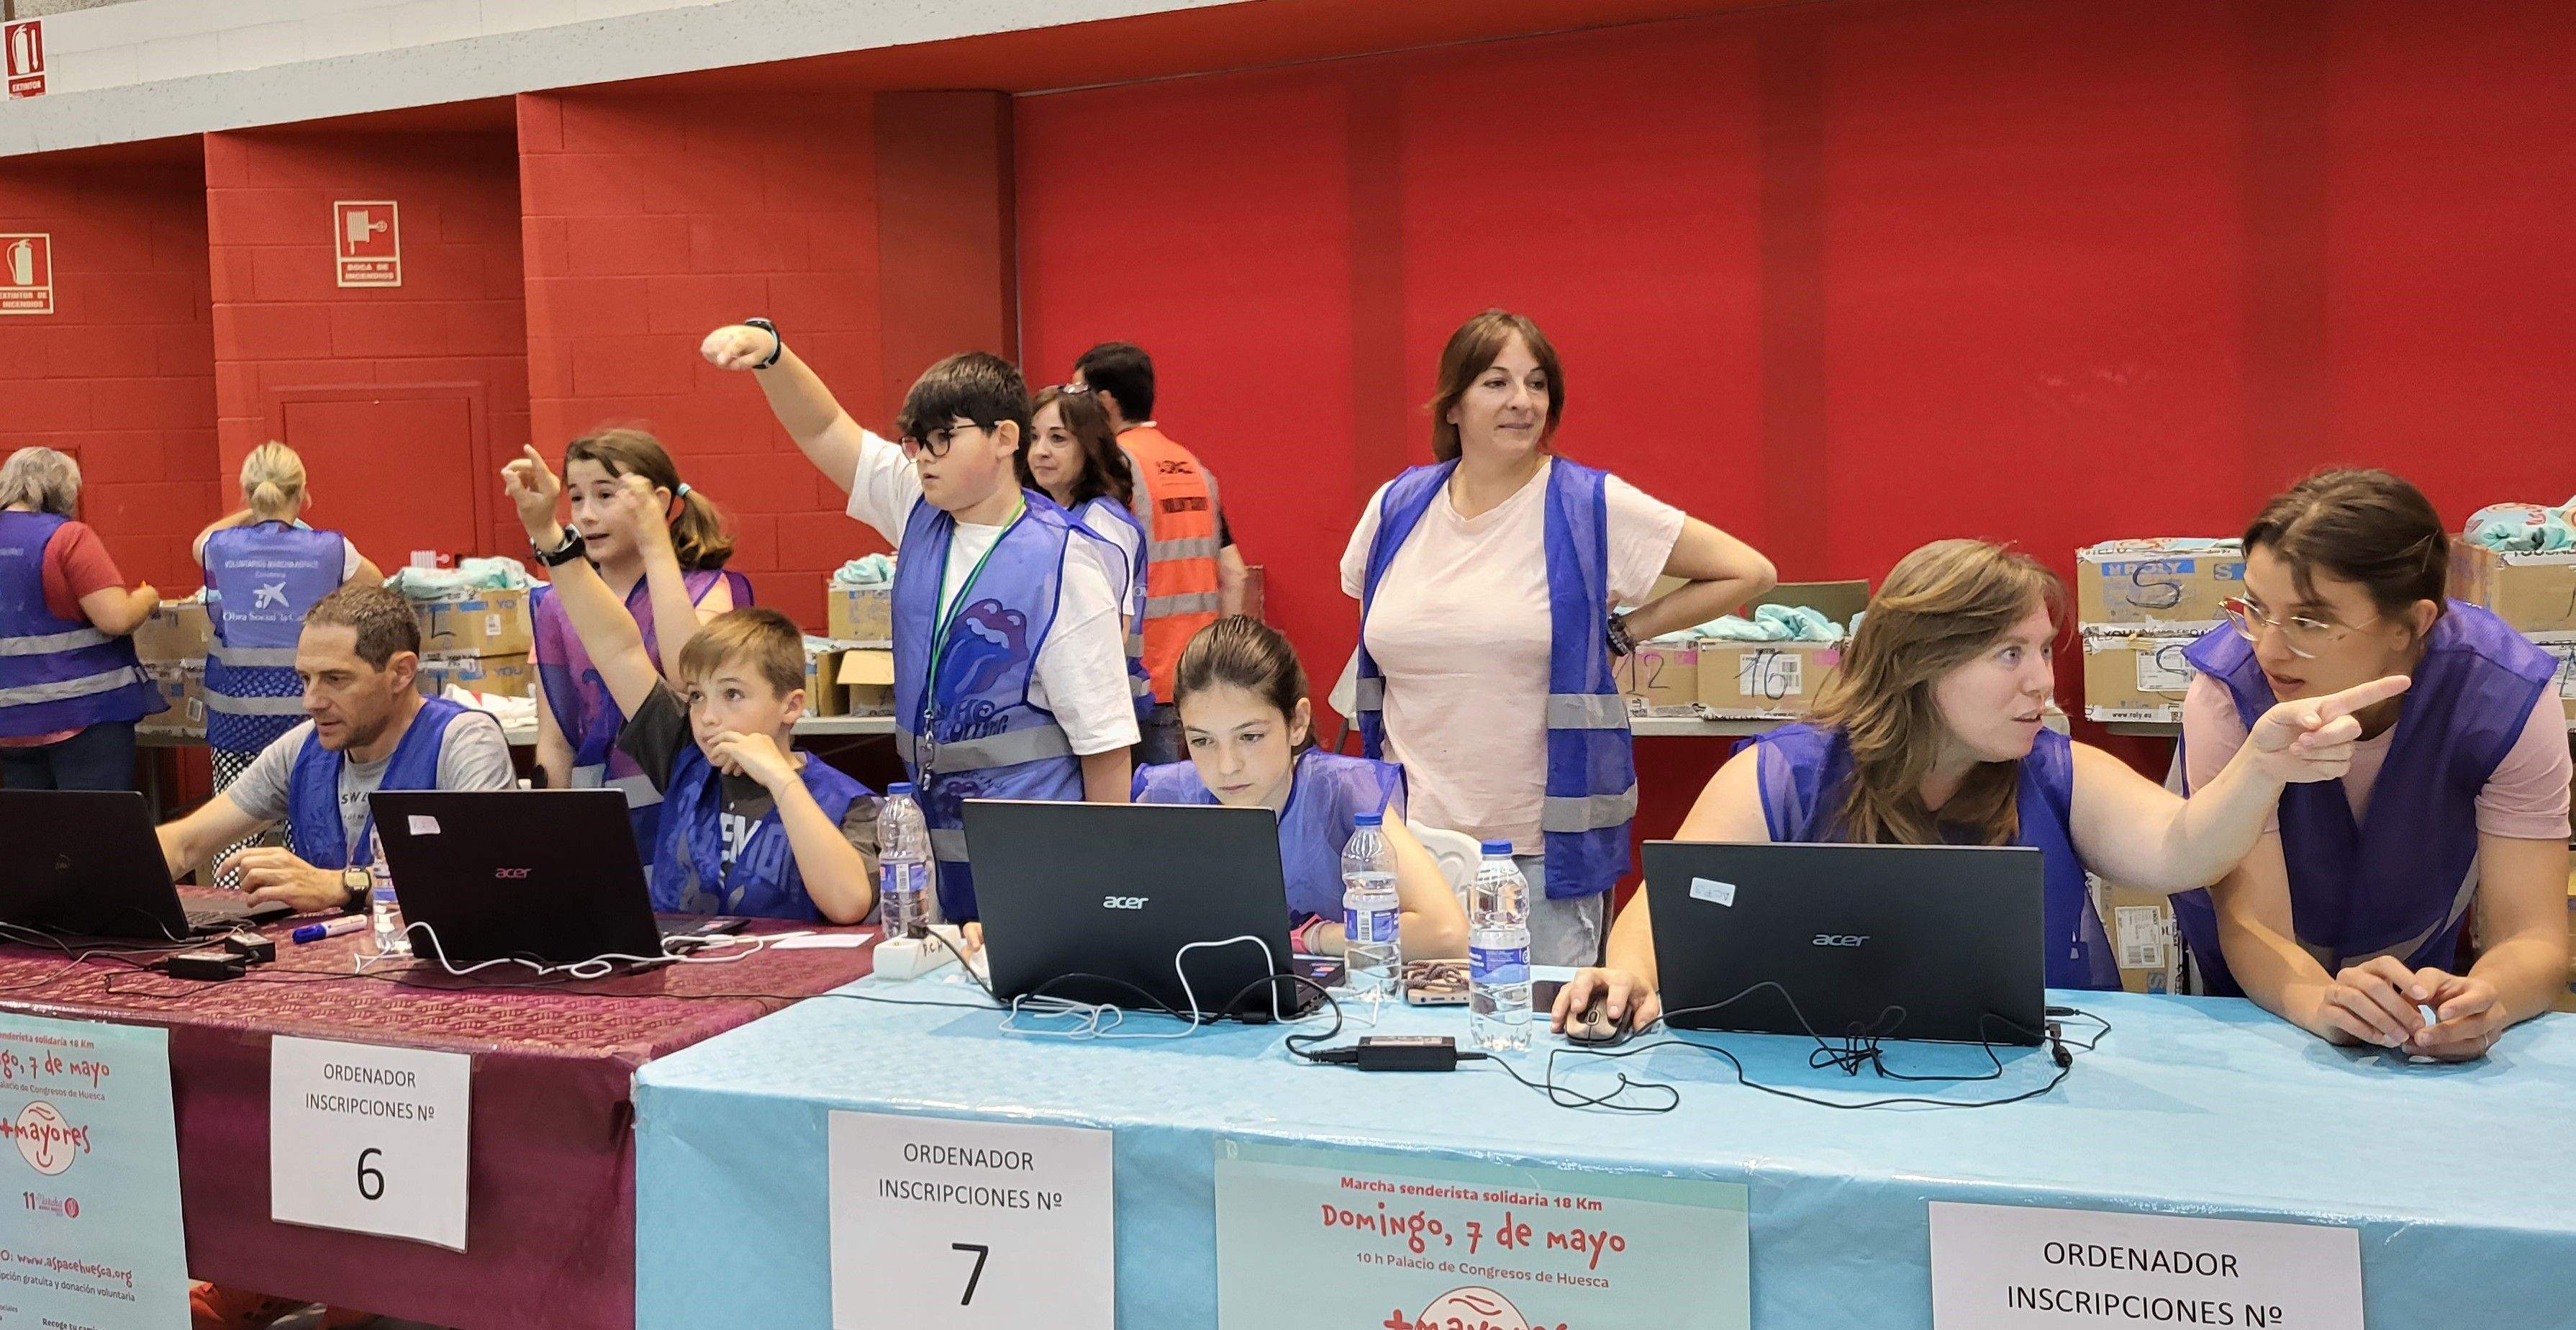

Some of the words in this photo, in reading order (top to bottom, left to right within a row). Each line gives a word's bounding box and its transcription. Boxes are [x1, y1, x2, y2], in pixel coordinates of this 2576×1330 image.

[496, 868, 532, 879] acer
[1103, 896, 1149, 909] acer
[1813, 934, 1870, 946] acer
[35, 1036, 67, 1046] solidaria
[81, 1040, 94, 1049] Km
[30, 1056, 38, 1079] 7
[45, 1049, 63, 1075] de
[70, 1061, 109, 1089] mayo
[324, 1063, 417, 1087] ORDENADOR
[20, 1083, 29, 1092] de
[30, 1085, 67, 1096] Congresos
[78, 1091, 105, 1101] Huesca
[306, 1092, 413, 1119] INSCRIPCIONES
[904, 1143, 1034, 1171] ORDENADOR
[358, 1148, 384, 1200] 6
[23, 1191, 36, 1210] 11
[879, 1178, 1030, 1209] INSCRIPCIONES
[1341, 1177, 1395, 1193] Marcha
[1400, 1185, 1479, 1201] senderista
[1483, 1190, 1548, 1207] solidaria
[1553, 1198, 1572, 1208] 18
[1577, 1198, 1602, 1211] Km
[1466, 1221, 1483, 1254] 7
[1496, 1211, 1532, 1249] de
[1547, 1229, 1626, 1270] mayo
[17, 1254, 133, 1288] www.aspacehuesca.org
[1356, 1253, 1371, 1264] 10
[1374, 1252, 1384, 1265] h
[1387, 1255, 1434, 1270] Palacio
[1439, 1260, 1455, 1272] de
[1459, 1263, 1531, 1281] Congresos
[1536, 1270, 1553, 1282] de
[1557, 1272, 1609, 1288] Huesca
[2044, 1241, 2239, 1277] ORDENADOR
[23, 1275, 53, 1287] gratuita
[55, 1280, 60, 1289] y
[61, 1280, 96, 1294] donación
[97, 1287, 135, 1301] voluntaria
[952, 1242, 989, 1306] 7
[2008, 1285, 2233, 1326] INSCRIPCIONES
